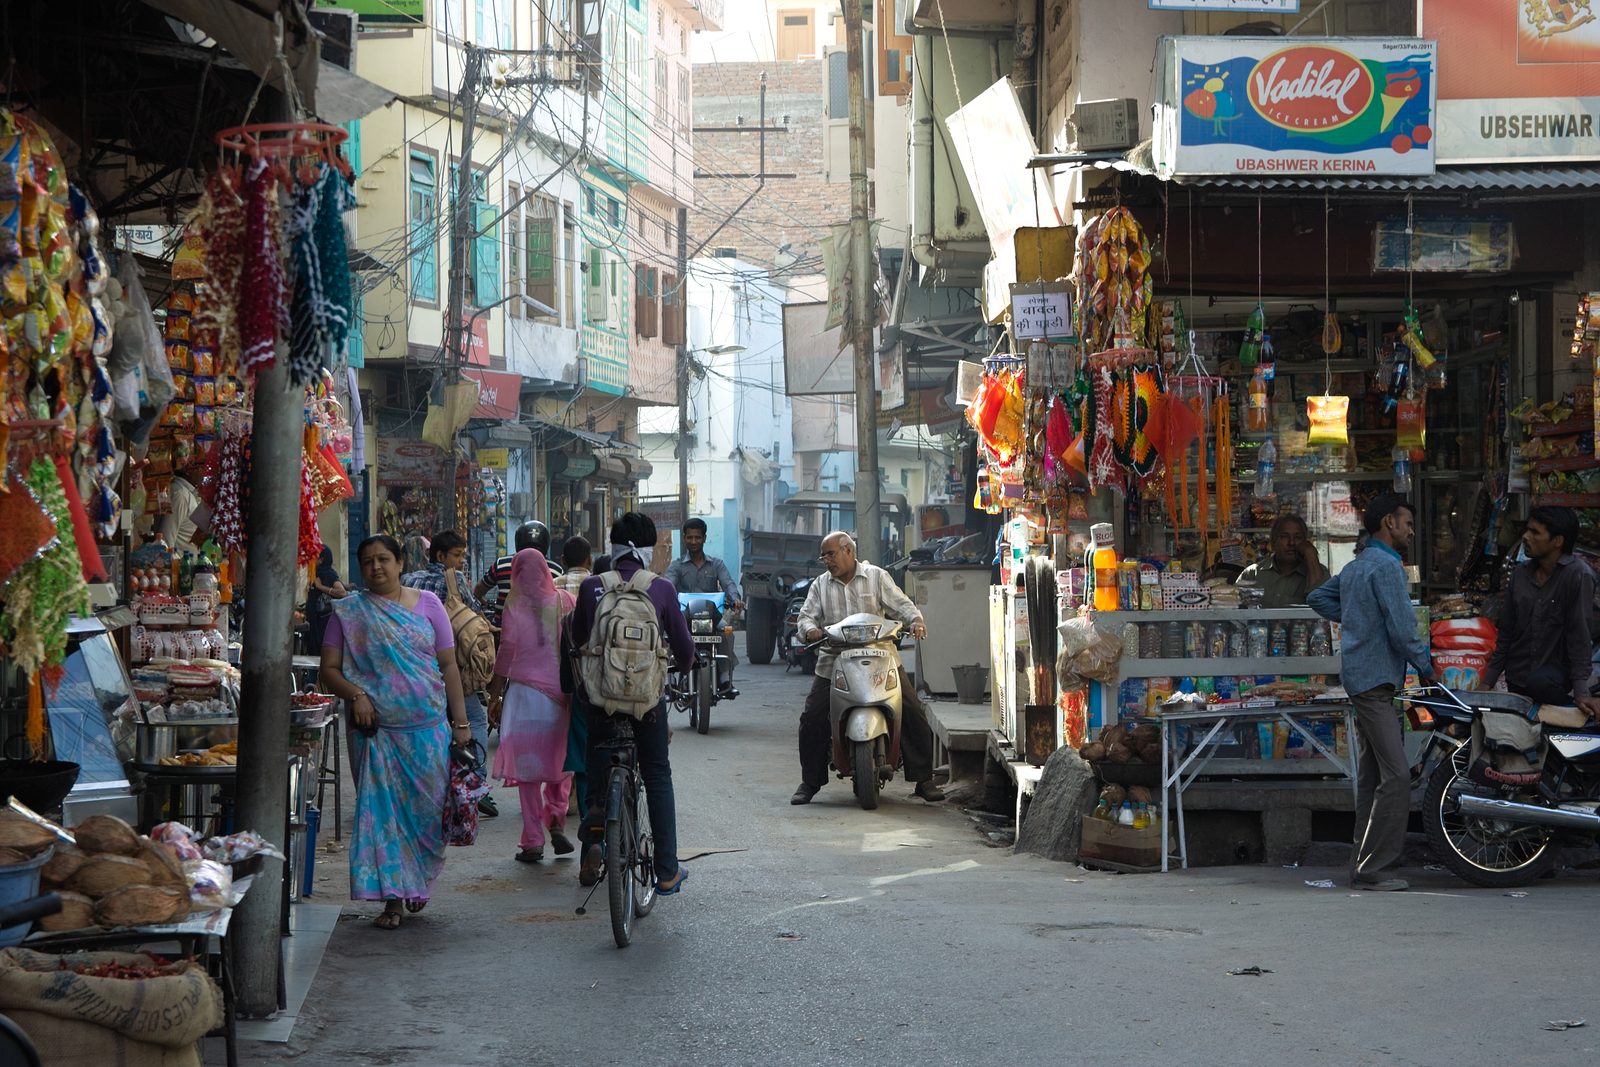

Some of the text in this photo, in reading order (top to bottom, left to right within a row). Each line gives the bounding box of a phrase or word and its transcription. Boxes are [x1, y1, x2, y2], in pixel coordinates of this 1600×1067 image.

[1255, 56, 1361, 115] Vadilal
[1268, 107, 1339, 127] ICE CREAM
[1480, 114, 1593, 139] UBSEHWAR
[1235, 159, 1377, 172] UBASHWER KERINA
[1021, 305, 1057, 316] चावल
